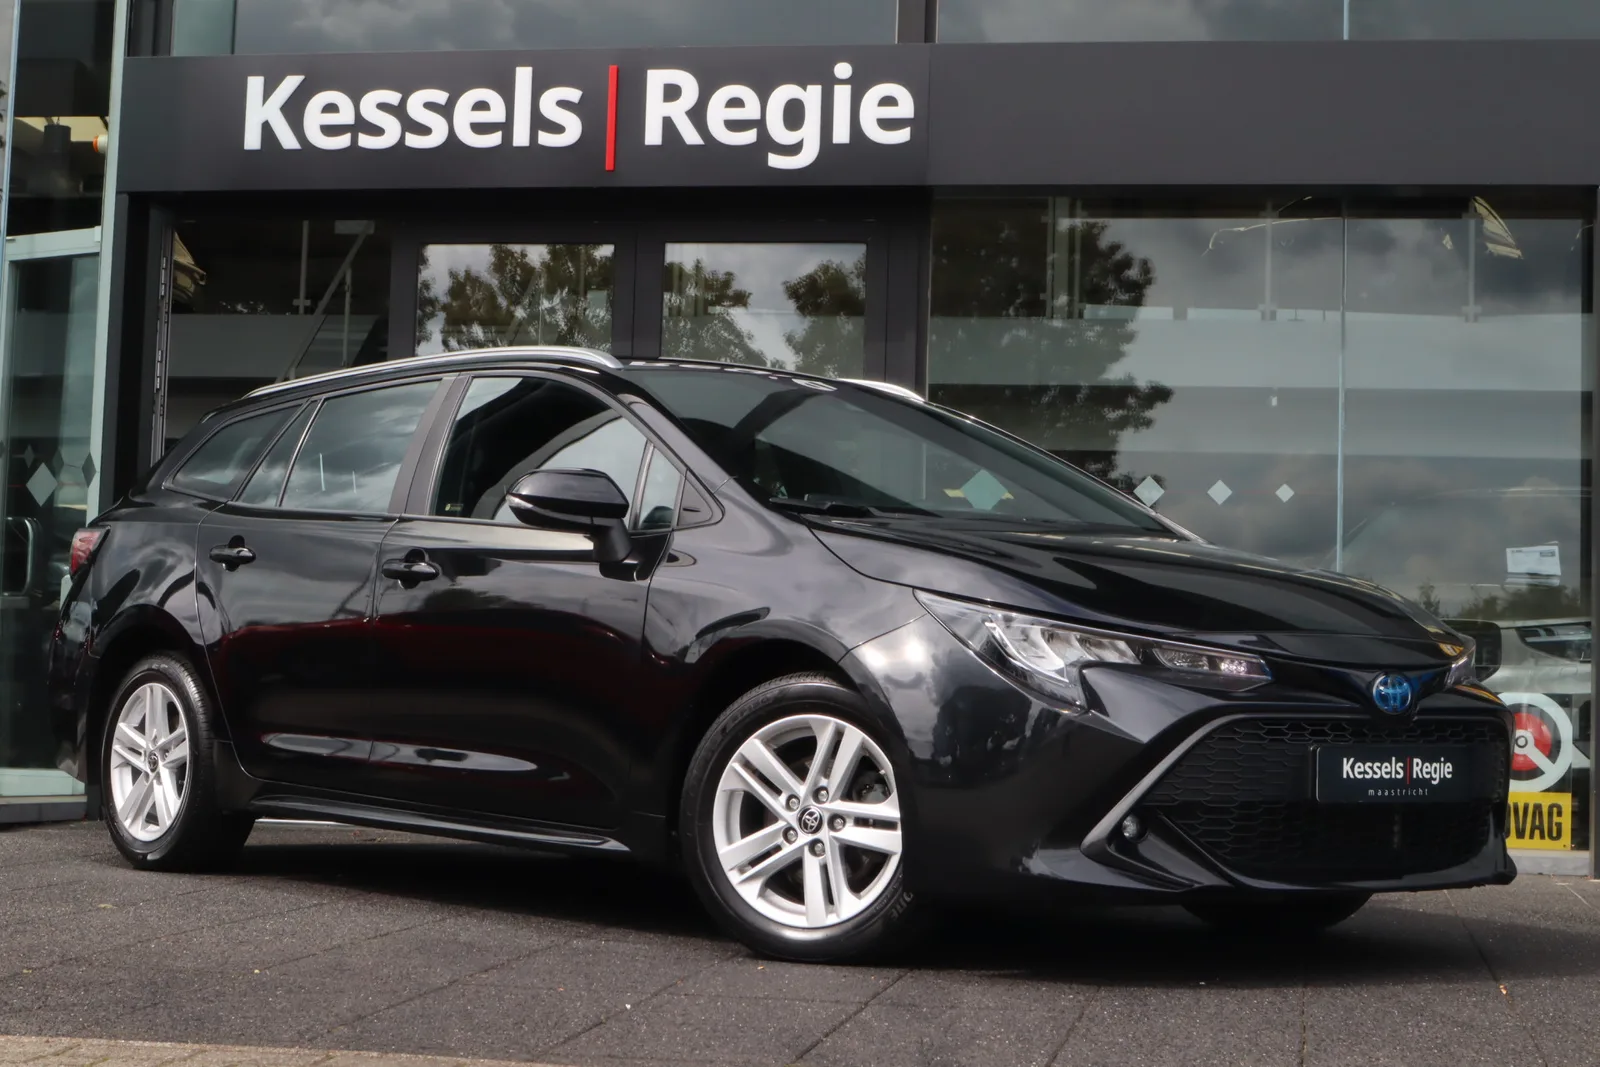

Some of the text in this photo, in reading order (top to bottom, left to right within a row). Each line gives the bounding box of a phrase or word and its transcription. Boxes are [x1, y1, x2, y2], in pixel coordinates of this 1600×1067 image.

[243, 61, 915, 170] Kessels Regie
[1342, 756, 1453, 785] Kessels Regie
[1368, 788, 1428, 796] maastricht
